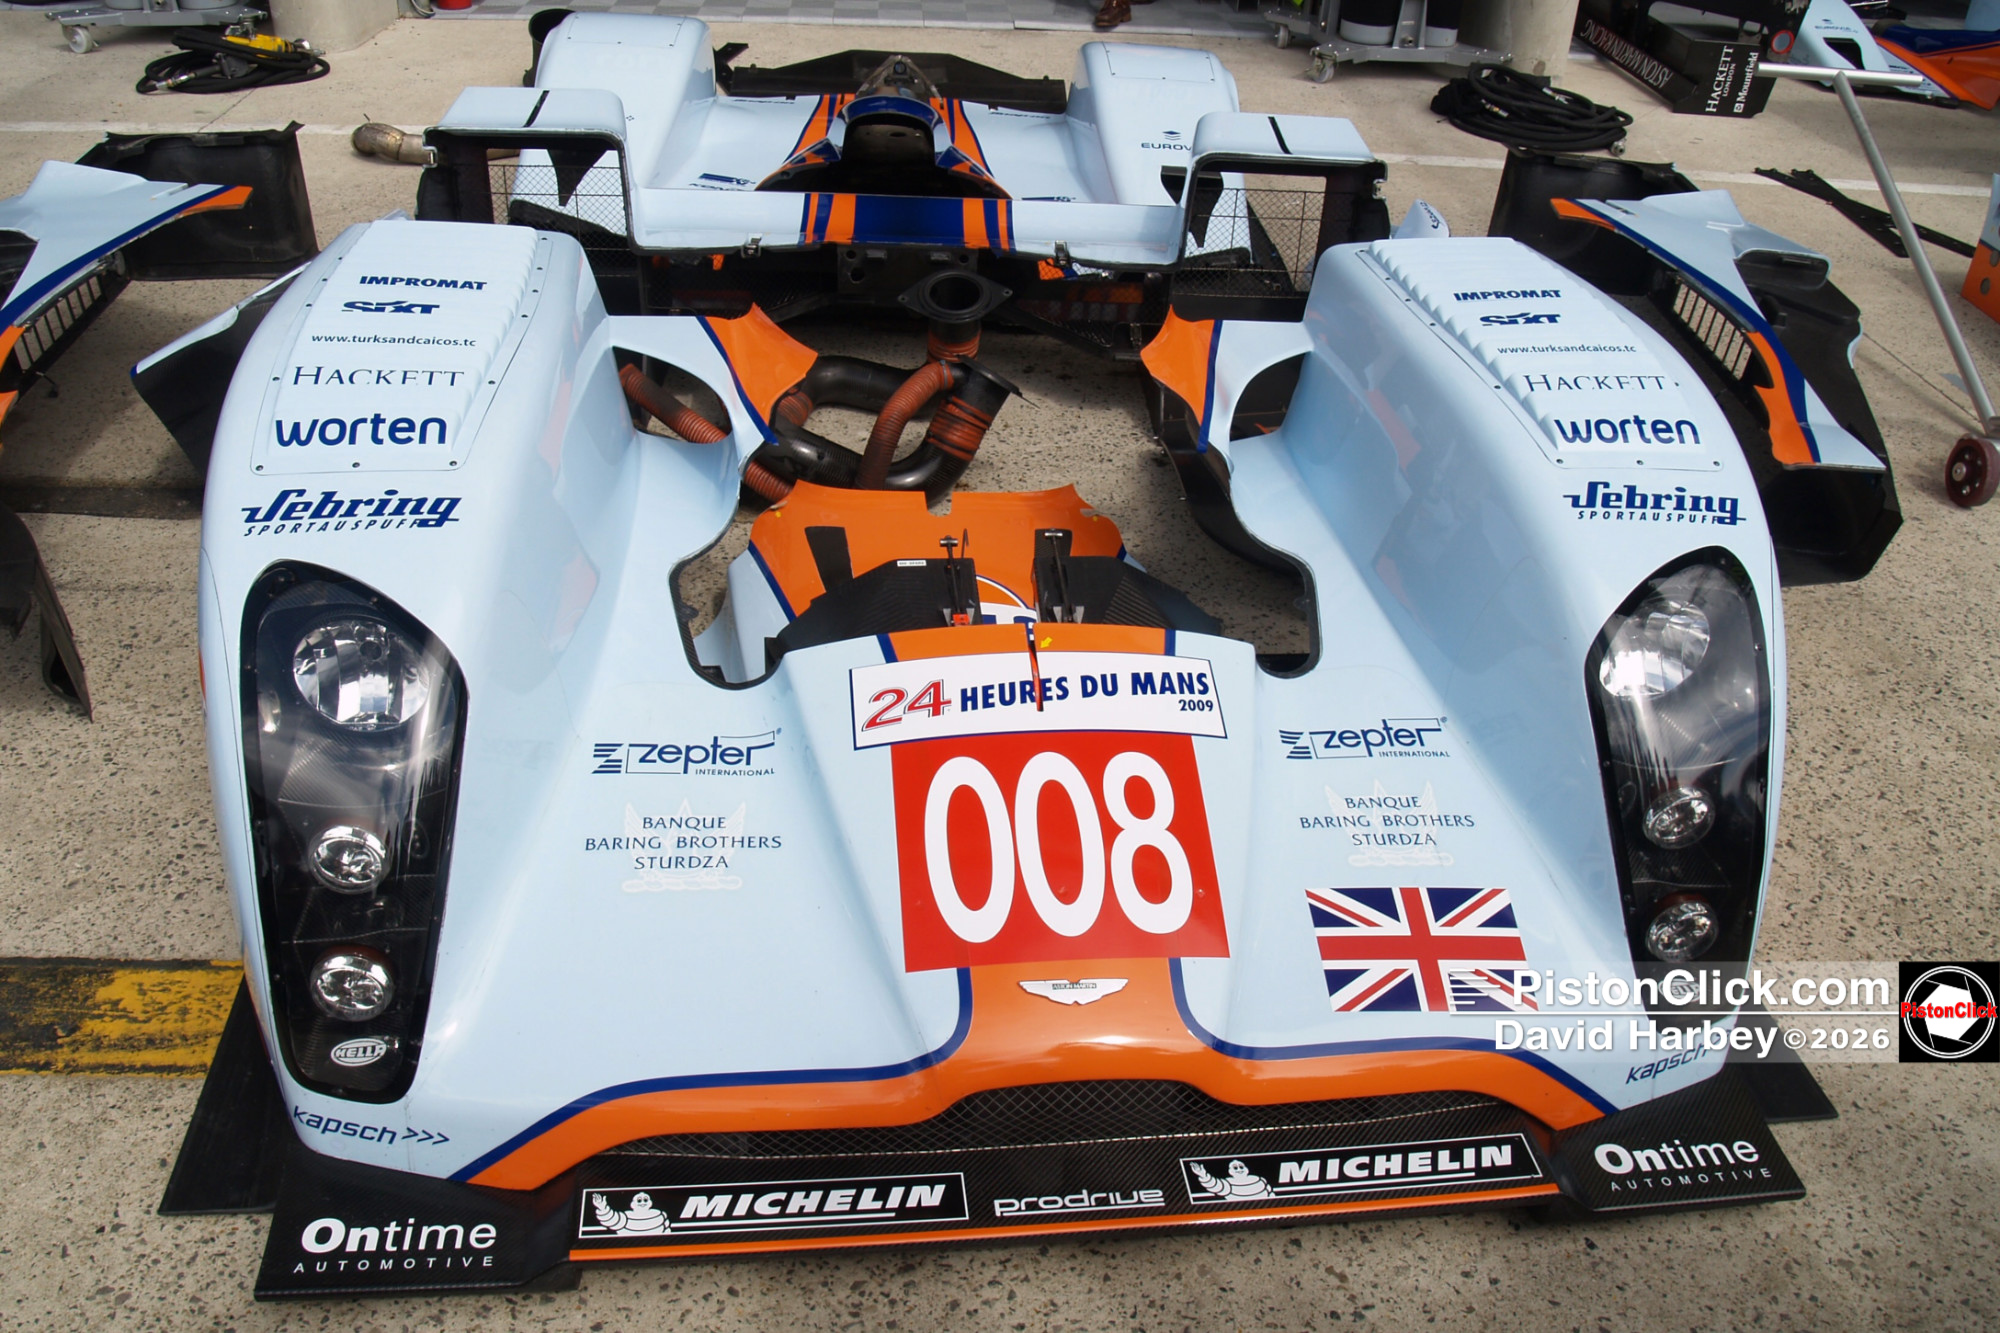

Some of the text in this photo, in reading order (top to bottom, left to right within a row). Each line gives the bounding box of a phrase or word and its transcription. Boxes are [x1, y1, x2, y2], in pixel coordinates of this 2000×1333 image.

[1580, 19, 1674, 89] ASTON MARTIN RACING
[1705, 45, 1734, 112] HACKETT
[1722, 63, 1736, 97] LONDON
[1735, 52, 1759, 102] Mountfield
[359, 275, 488, 291] IMPROMAT
[1453, 289, 1562, 302] IMPROMAT
[311, 334, 477, 347] www.turksandcaicos.tc
[1497, 344, 1637, 354] www.turksandcaicos.tc
[293, 366, 465, 387] HACKETT
[1523, 374, 1667, 392] HACKETT
[275, 413, 448, 447] worten
[1553, 415, 1701, 445] worten
[241, 488, 462, 528] Sebring
[1562, 481, 1747, 526] Sebring
[1577, 510, 1720, 524] SPORTAUSPUFF
[243, 518, 423, 537] SPORTAUSPUFF
[861, 671, 1210, 732] 24 HEURES DU MANS
[1178, 699, 1214, 713] 2009
[1378, 750, 1451, 758] INTERNATIONAL
[695, 767, 775, 777] INTERNATIONAL
[1344, 796, 1422, 810] BANQUE
[642, 816, 727, 832] BANQUE
[1299, 814, 1475, 829] BARING BROTHERS
[585, 835, 782, 851] BARING BROTHERS
[924, 751, 1193, 944] 008
[1351, 833, 1437, 847] STURDZA
[634, 855, 729, 870] STURDZA
[335, 1044, 386, 1058] HELLA
[293, 1105, 397, 1145] kapsch
[1278, 1145, 1512, 1182] MICHELIN
[1594, 1138, 1760, 1175] Ontime
[1610, 1167, 1773, 1192] AUTOMOTIVE
[679, 1184, 946, 1219] MICHELIN
[994, 1188, 1164, 1216] prodrive
[300, 1217, 497, 1254] Ontime
[293, 1256, 494, 1273] AUTOMOTIVE
